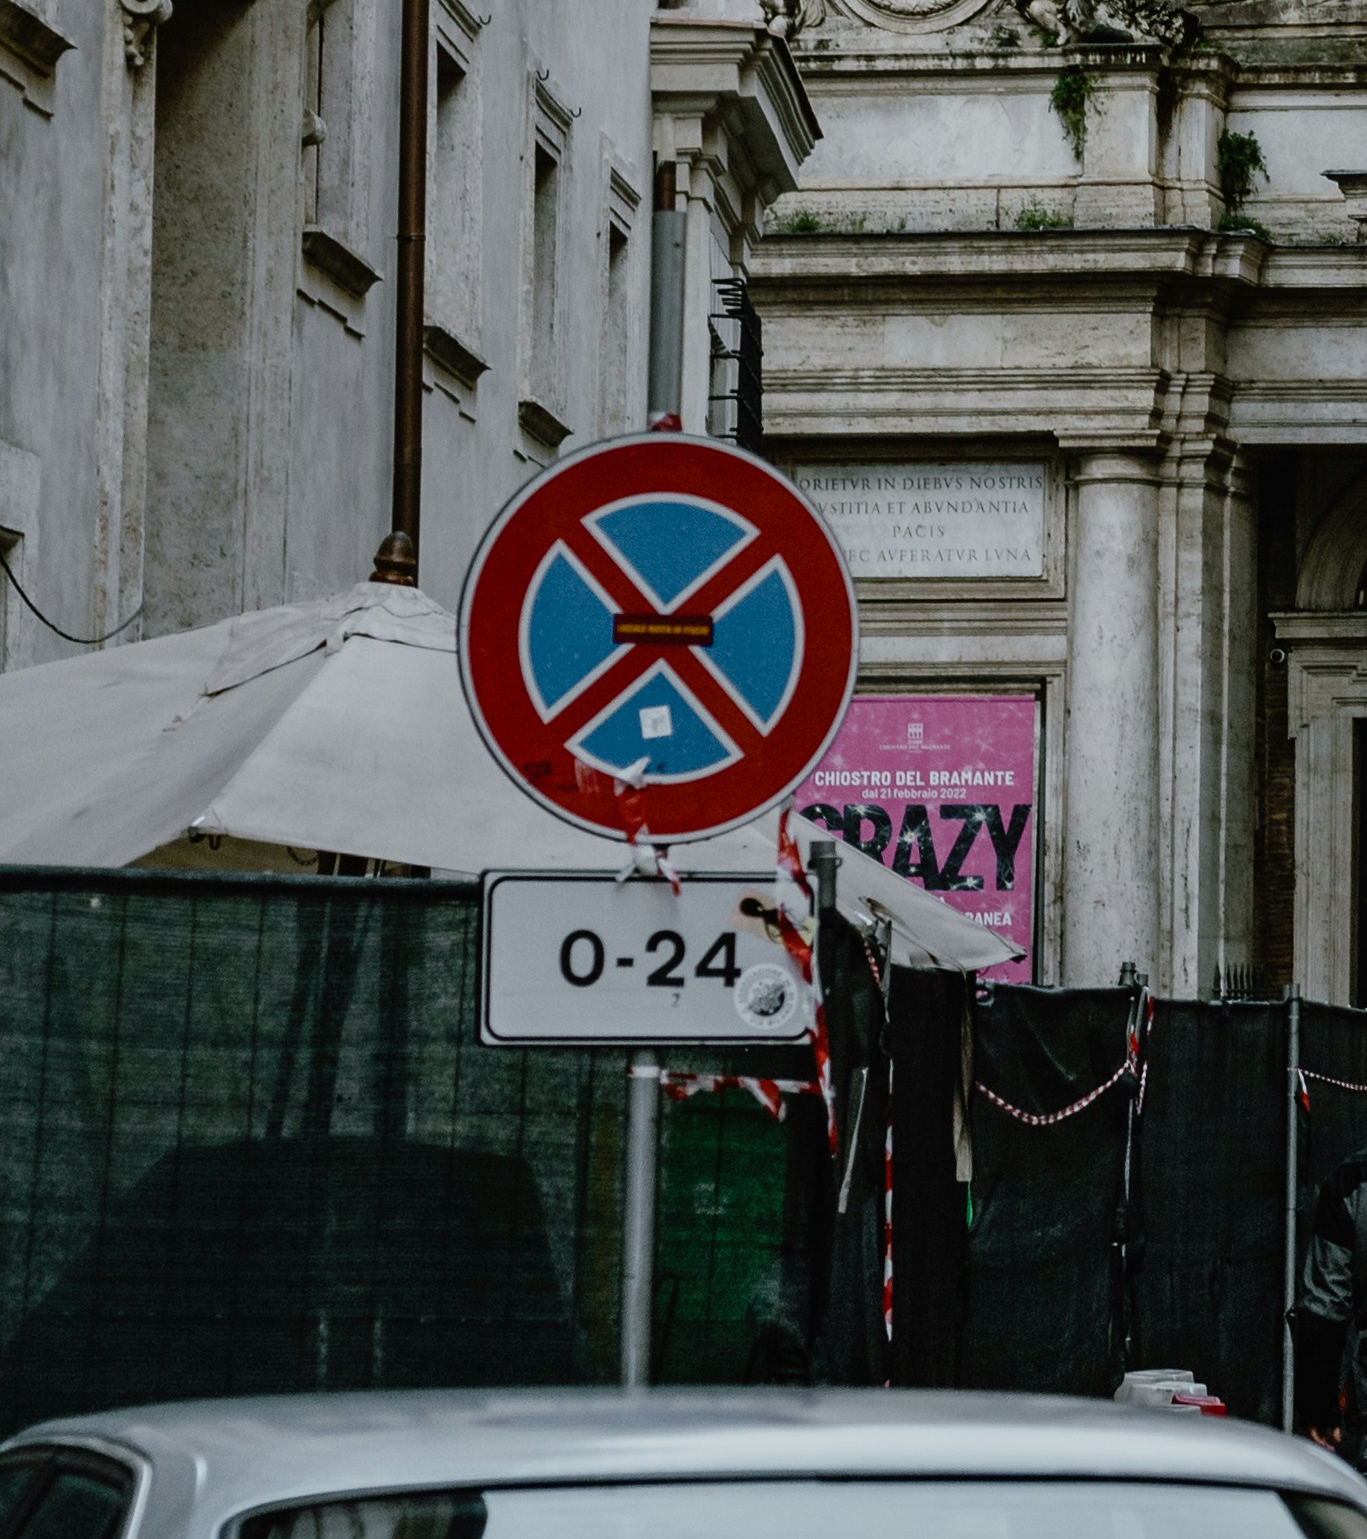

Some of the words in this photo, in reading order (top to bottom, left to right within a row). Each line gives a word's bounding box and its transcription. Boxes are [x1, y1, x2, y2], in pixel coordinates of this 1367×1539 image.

[799, 476, 872, 491] ORIETVR
[877, 477, 896, 490] IN
[902, 476, 963, 491] DIEBVS
[969, 475, 1043, 490] NOSTRIS
[816, 500, 881, 515] VSTITIA
[887, 501, 906, 515] ET
[911, 500, 1029, 514] ABVNDANTIA
[892, 524, 945, 538] PACIS
[877, 548, 979, 563] AVFERATVR
[984, 548, 1031, 562] LVNA
[814, 770, 893, 787] CHIOSTRO
[895, 770, 926, 786] DEL
[928, 770, 1015, 787] BRAMANTE
[861, 787, 878, 800] dal
[879, 788, 891, 800] 21
[891, 787, 939, 800] febbraio
[940, 787, 967, 800] 2022
[963, 911, 1012, 926] RANEA
[560, 927, 742, 989] 0-24
